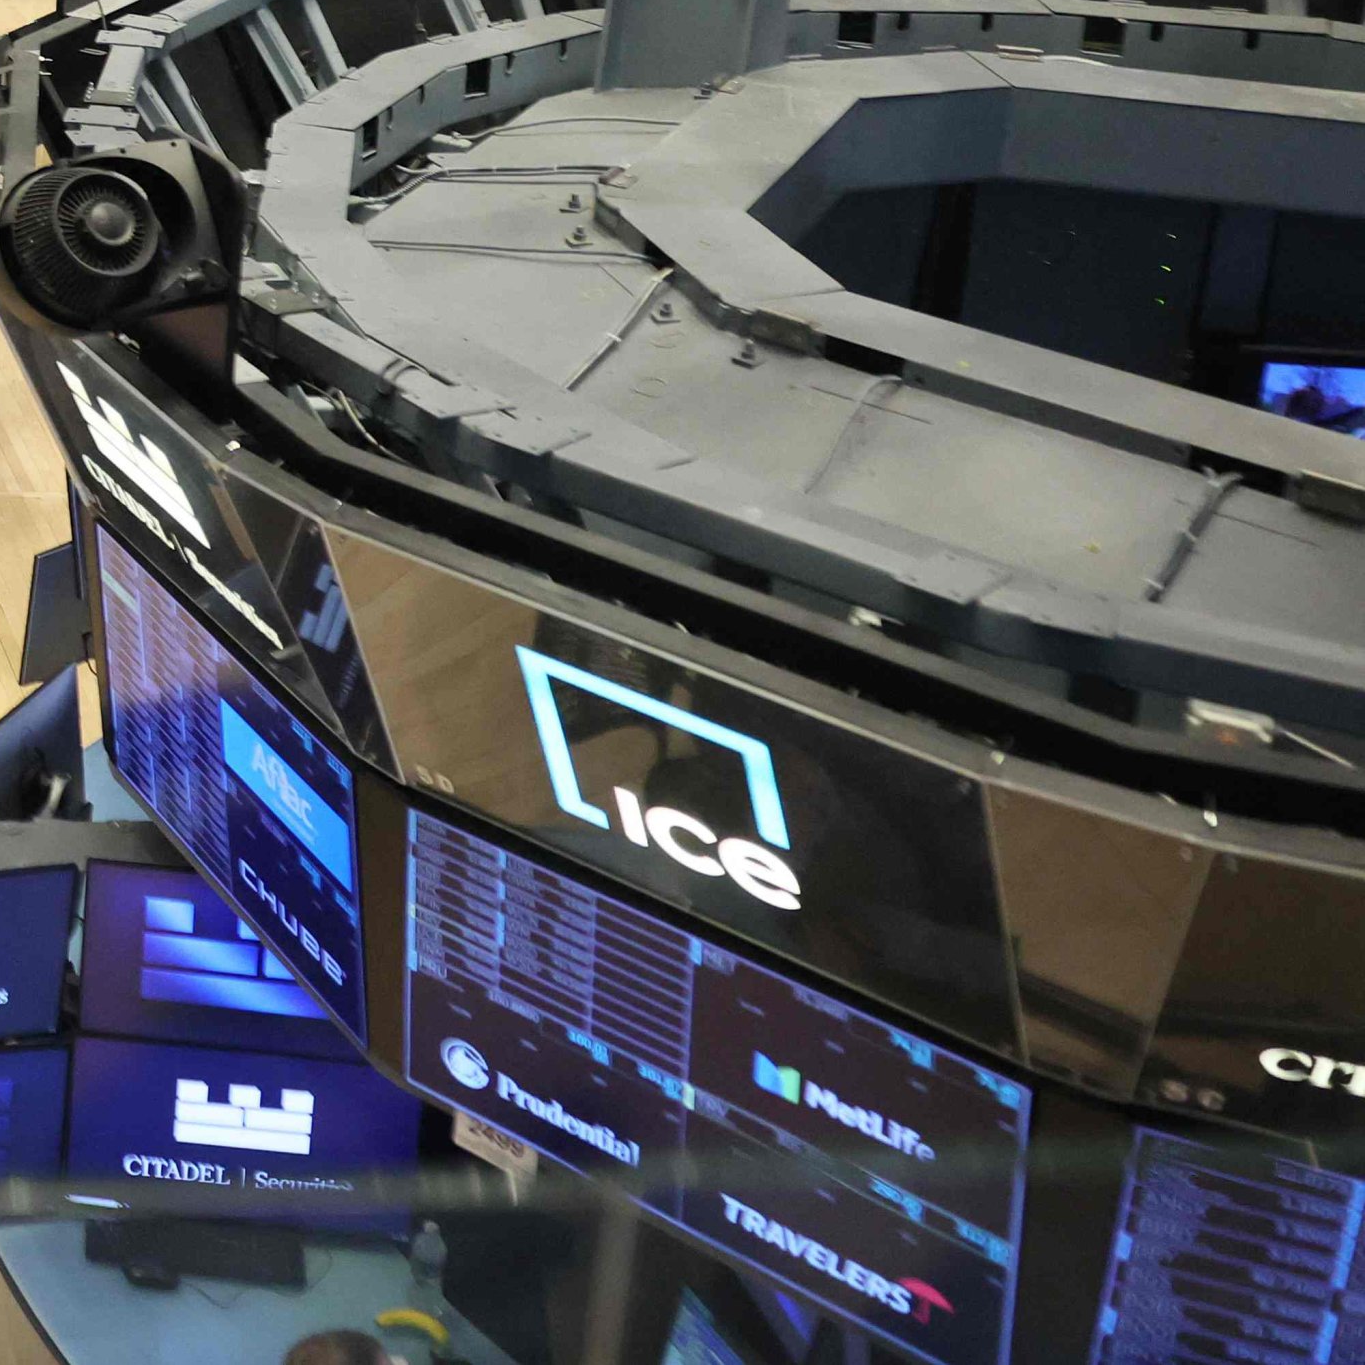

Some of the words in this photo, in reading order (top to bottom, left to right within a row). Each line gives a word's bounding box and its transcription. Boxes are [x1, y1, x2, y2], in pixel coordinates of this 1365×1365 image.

[238, 857, 342, 987] CHUBB
[495, 1070, 641, 1168] Prudential
[804, 1080, 937, 1164] MetLife
[122, 1153, 230, 1186] CITADEL
[719, 1192, 913, 1316] TRAVELERS
